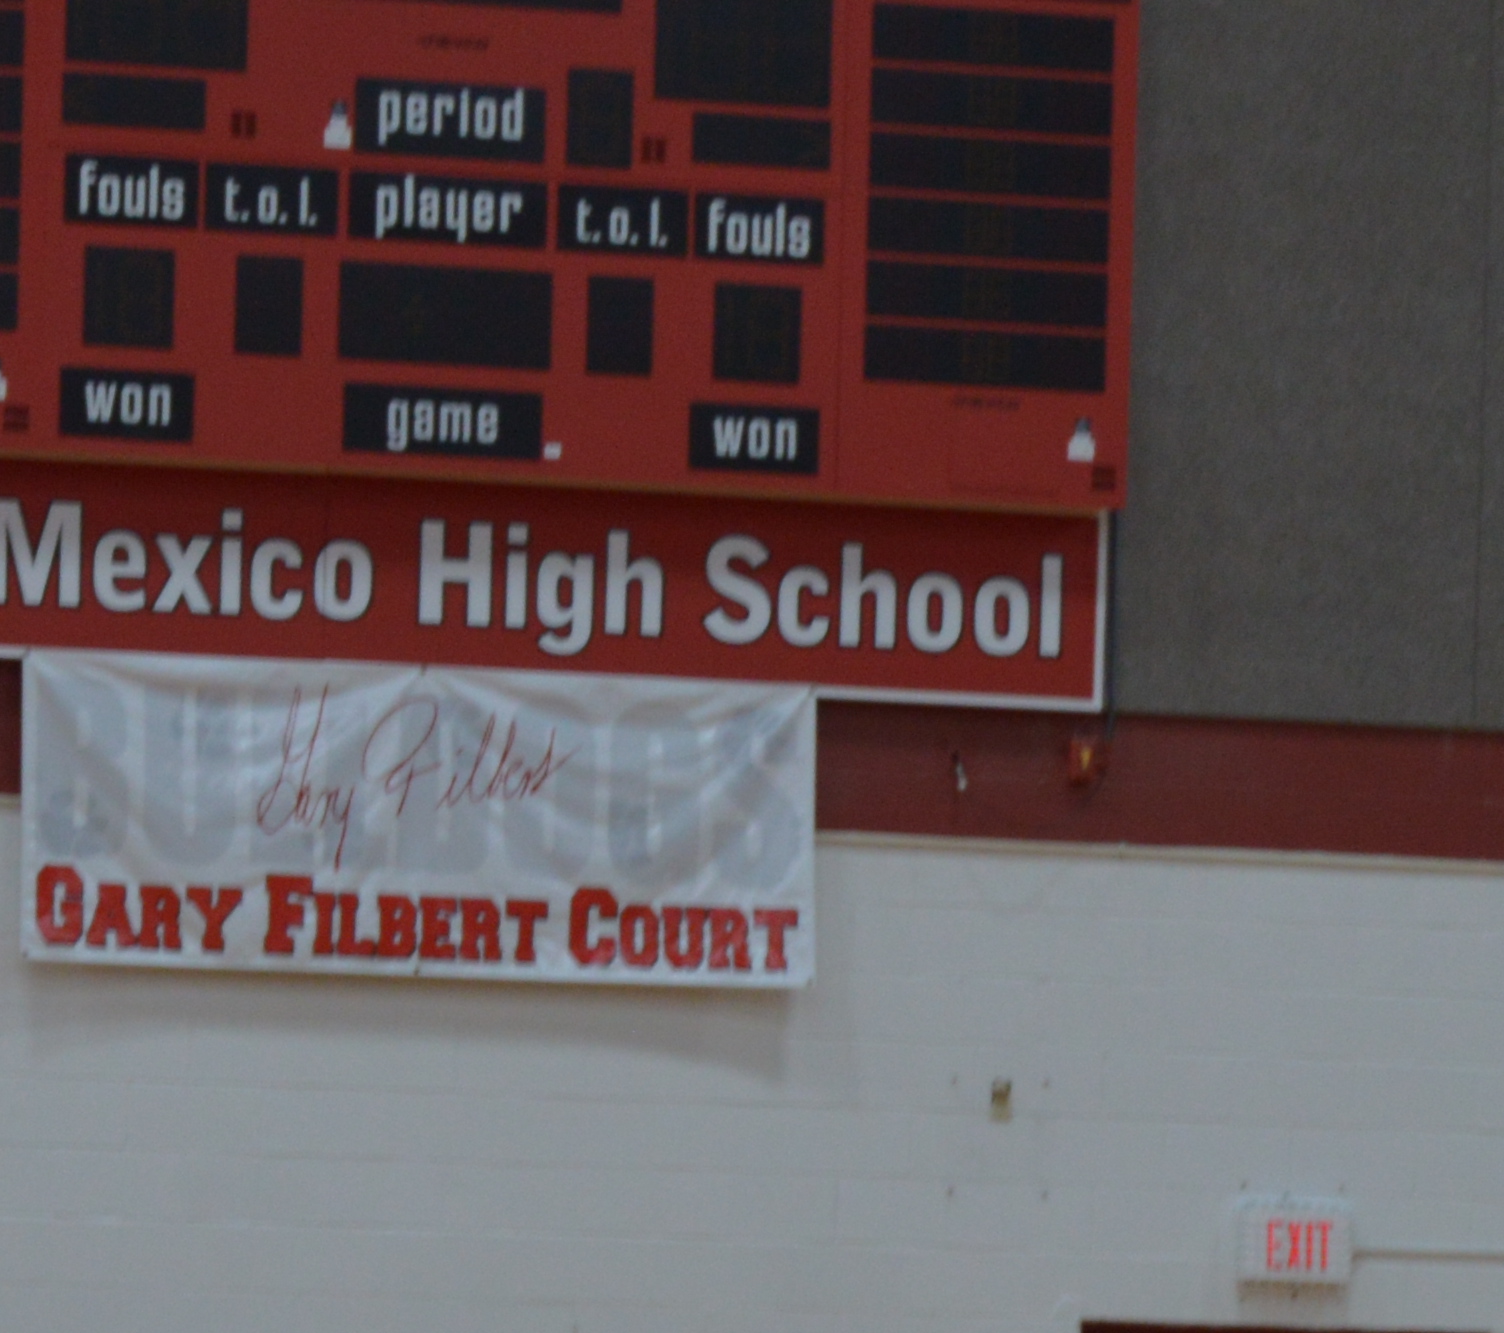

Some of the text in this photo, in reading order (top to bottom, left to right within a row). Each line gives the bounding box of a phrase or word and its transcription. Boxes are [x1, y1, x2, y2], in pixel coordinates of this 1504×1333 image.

[377, 88, 526, 146] period
[78, 159, 185, 219] fouls
[374, 173, 523, 243] player
[707, 198, 811, 258] fouls
[84, 379, 172, 427] won
[386, 398, 499, 452] game
[712, 415, 797, 460] won
[418, 517, 664, 656] High
[702, 533, 1063, 659] School
[36, 865, 798, 971] GARY FILBERT COURT
[1265, 1218, 1333, 1273] EXIT
